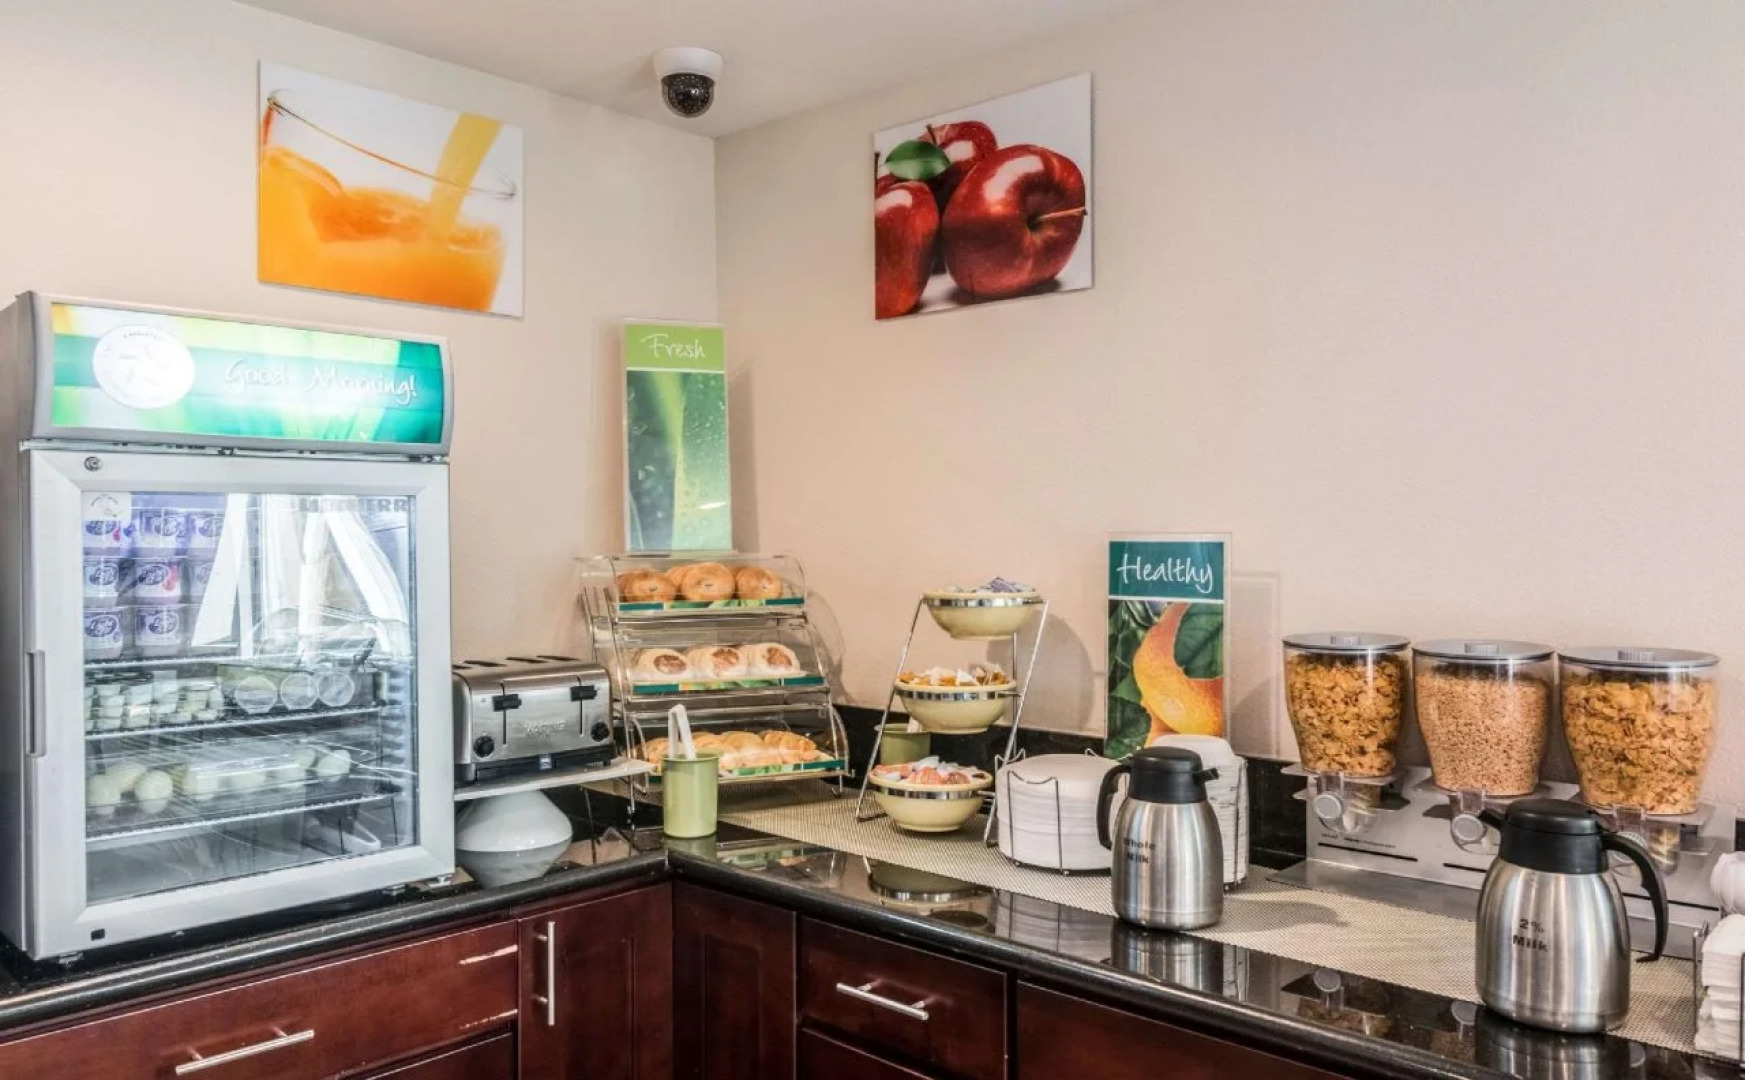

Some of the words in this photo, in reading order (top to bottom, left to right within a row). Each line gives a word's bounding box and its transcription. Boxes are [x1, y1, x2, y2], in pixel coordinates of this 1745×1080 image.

[640, 333, 706, 360] Fresh
[224, 358, 287, 395] Good
[299, 363, 418, 406] Morning!
[1116, 553, 1213, 594] Healthy
[1127, 851, 1149, 864] Milk
[1519, 918, 1544, 934] 2%
[1513, 934, 1548, 952] Milk
